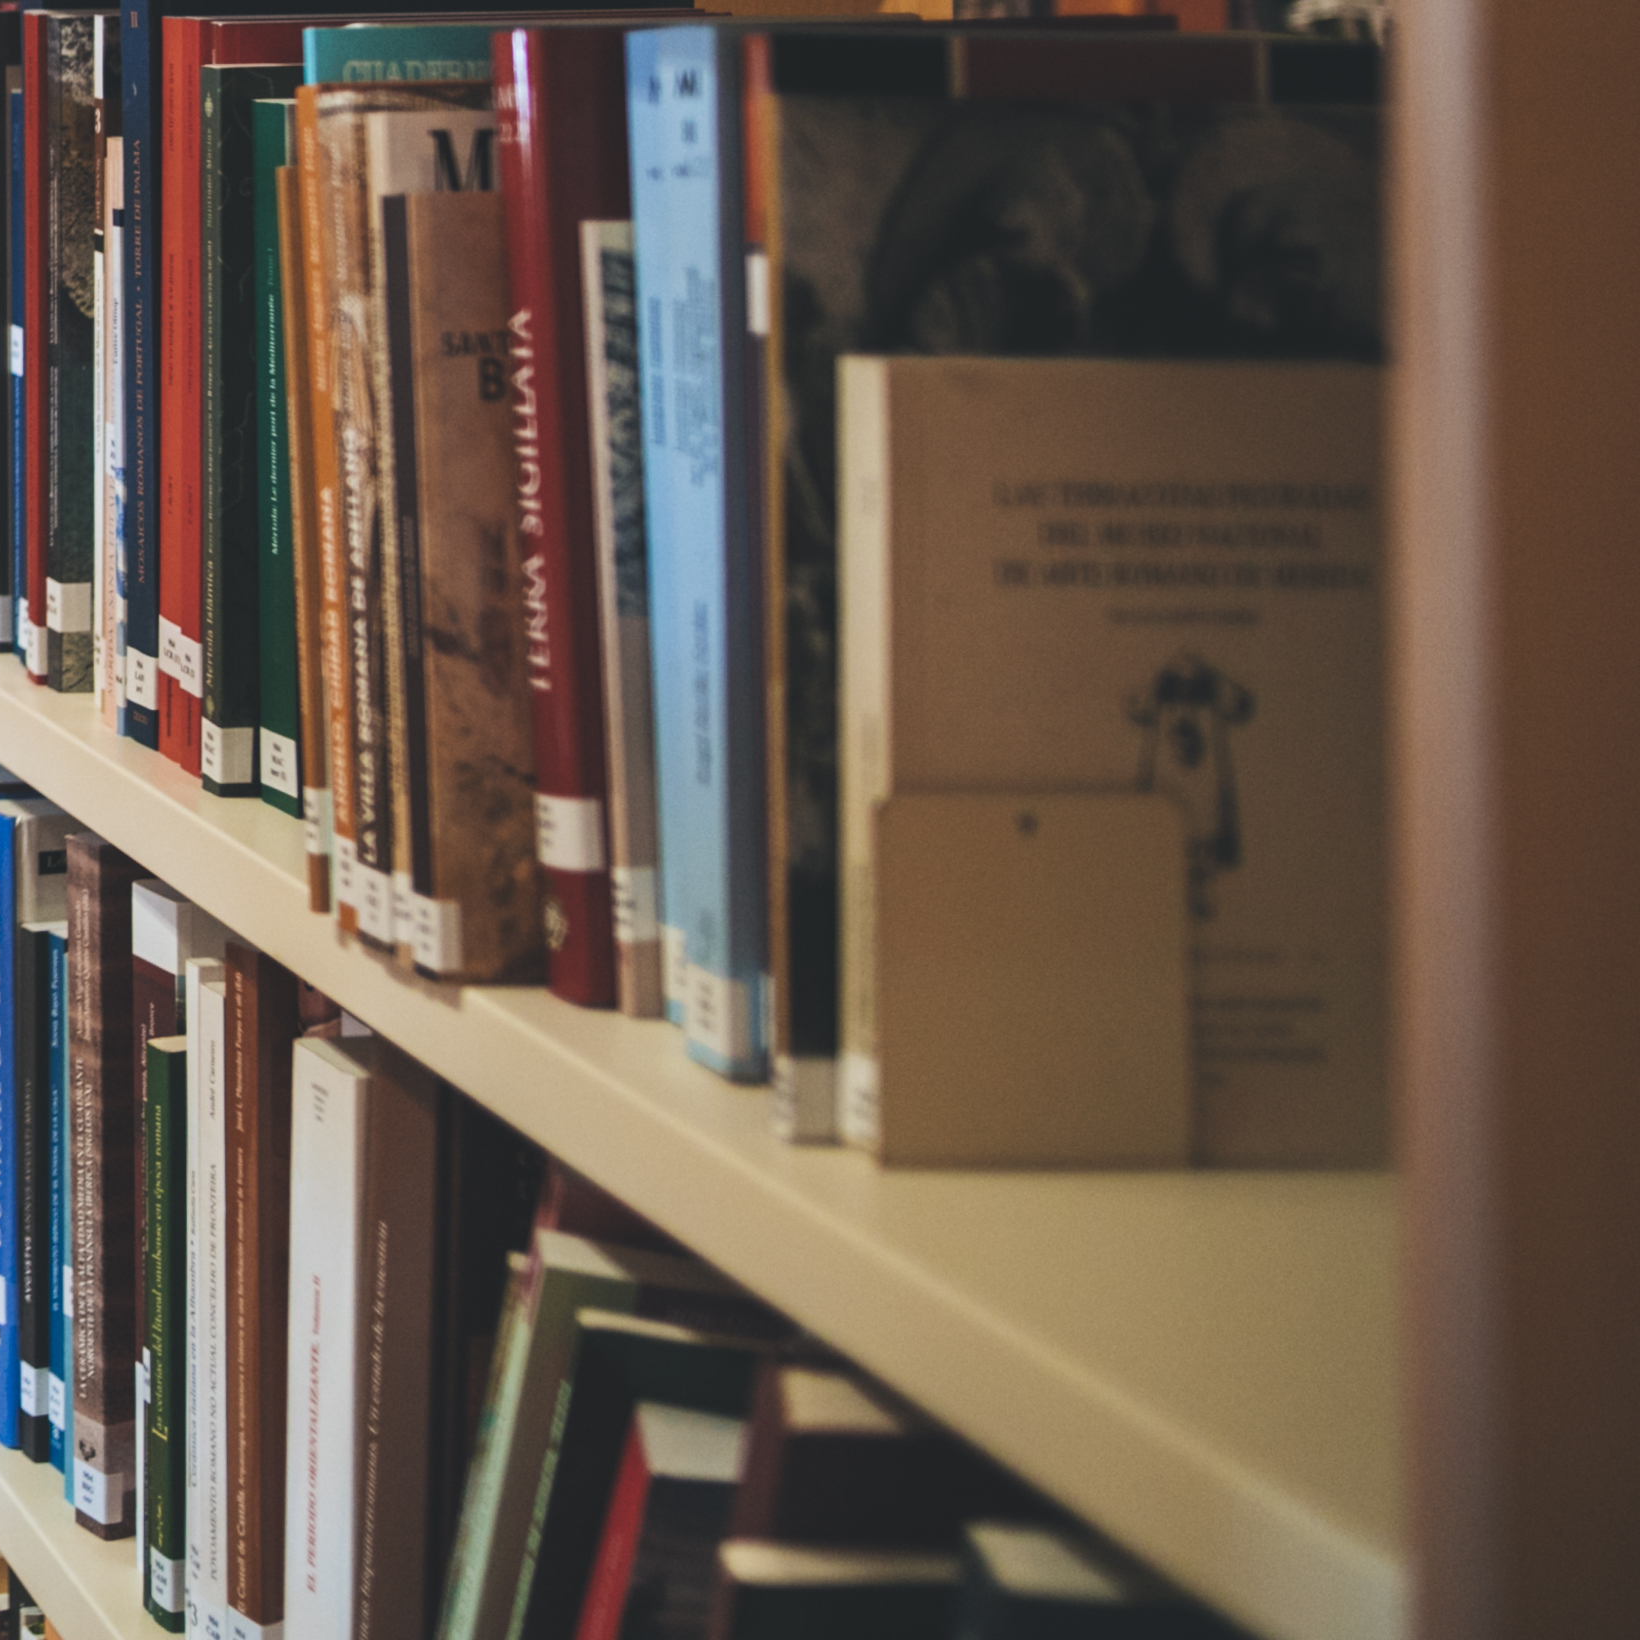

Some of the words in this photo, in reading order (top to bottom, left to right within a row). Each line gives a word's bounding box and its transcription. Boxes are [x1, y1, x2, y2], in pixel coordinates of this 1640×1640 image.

[132, 138, 141, 195] PALMA
[133, 199, 141, 221] DE
[133, 225, 142, 279] TORRE
[134, 299, 143, 385] PORTUGAL
[135, 390, 144, 411] DE
[506, 307, 544, 538] SIGILLATA
[136, 415, 145, 496] ROMANOS
[344, 427, 365, 568] ARELLANO
[137, 501, 146, 584] MOSAICOS
[320, 487, 338, 603] ROMANA
[351, 576, 366, 610] DE
[521, 554, 552, 693] TERRA
[353, 618, 372, 744] ROMANA
[358, 751, 376, 824] VILLA
[361, 830, 378, 863] LA
[208, 1040, 216, 1085] Carneiro
[154, 1105, 162, 1156] romana
[153, 1160, 164, 1199] época
[154, 1203, 162, 1220] en
[152, 1223, 162, 1288] onubense
[210, 1240, 216, 1258] DE
[151, 1289, 163, 1333] litoral
[189, 1252, 197, 1321] Alhambra
[151, 1337, 163, 1356] del
[189, 1325, 197, 1338] la
[190, 1343, 197, 1359] en
[154, 1359, 163, 1412] cetariae
[210, 1396, 217, 1418] NO
[152, 1416, 168, 1442] Las
[308, 1341, 320, 1489] ORIENTALIZANTE
[210, 1486, 218, 1582] POVOAMENTO
[306, 1573, 316, 1593] EL
